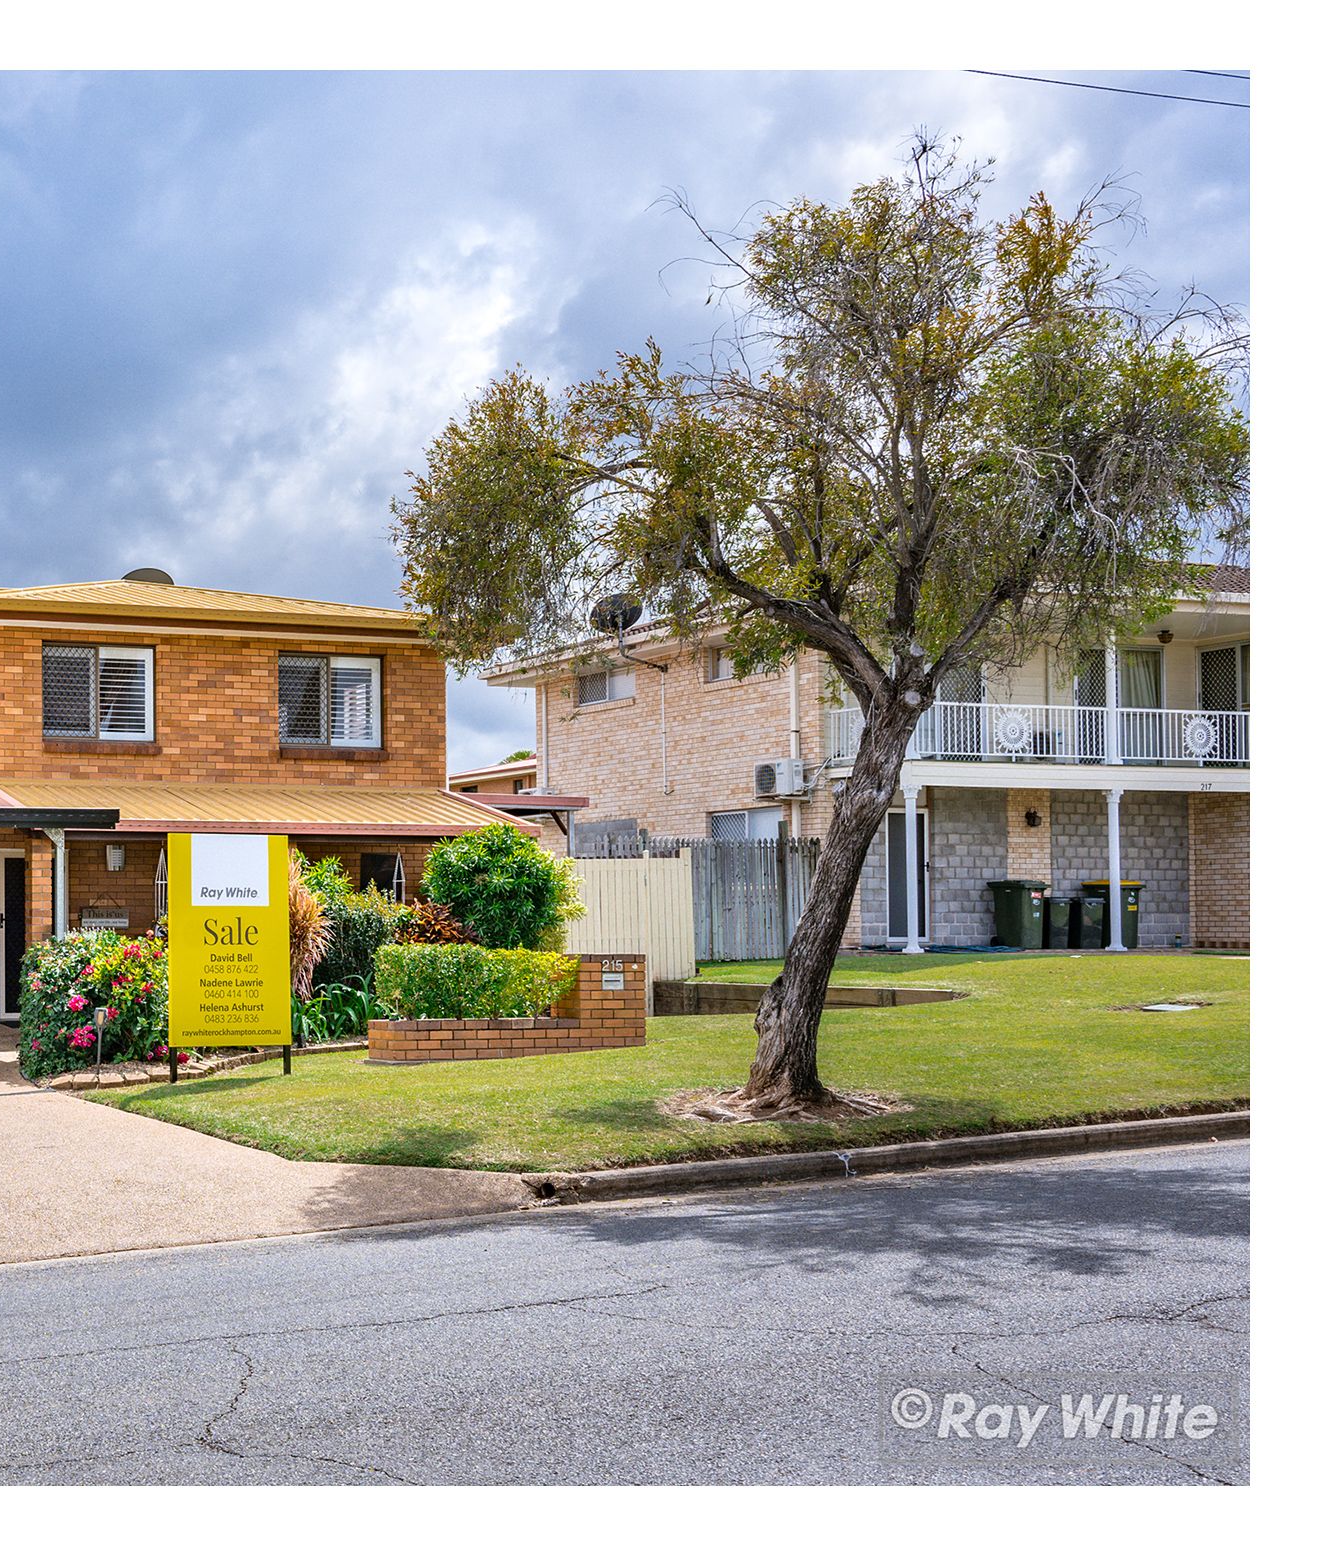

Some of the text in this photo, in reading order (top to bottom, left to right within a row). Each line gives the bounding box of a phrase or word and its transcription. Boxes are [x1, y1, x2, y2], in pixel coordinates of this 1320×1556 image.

[1200, 783, 1212, 791] 217
[200, 886, 258, 900] Ray White
[203, 916, 259, 946] Sale
[210, 953, 253, 962] David Bell
[203, 964, 259, 974] 0458 876 422
[602, 959, 623, 971] 215
[199, 978, 264, 987] Nadene Lawrie
[204, 989, 259, 999] 0460 414 100
[199, 1003, 264, 1012] Helena Ashurst
[204, 1014, 259, 1024] 0483 236 836
[182, 1028, 282, 1038] raywhiterockhampton.com.au
